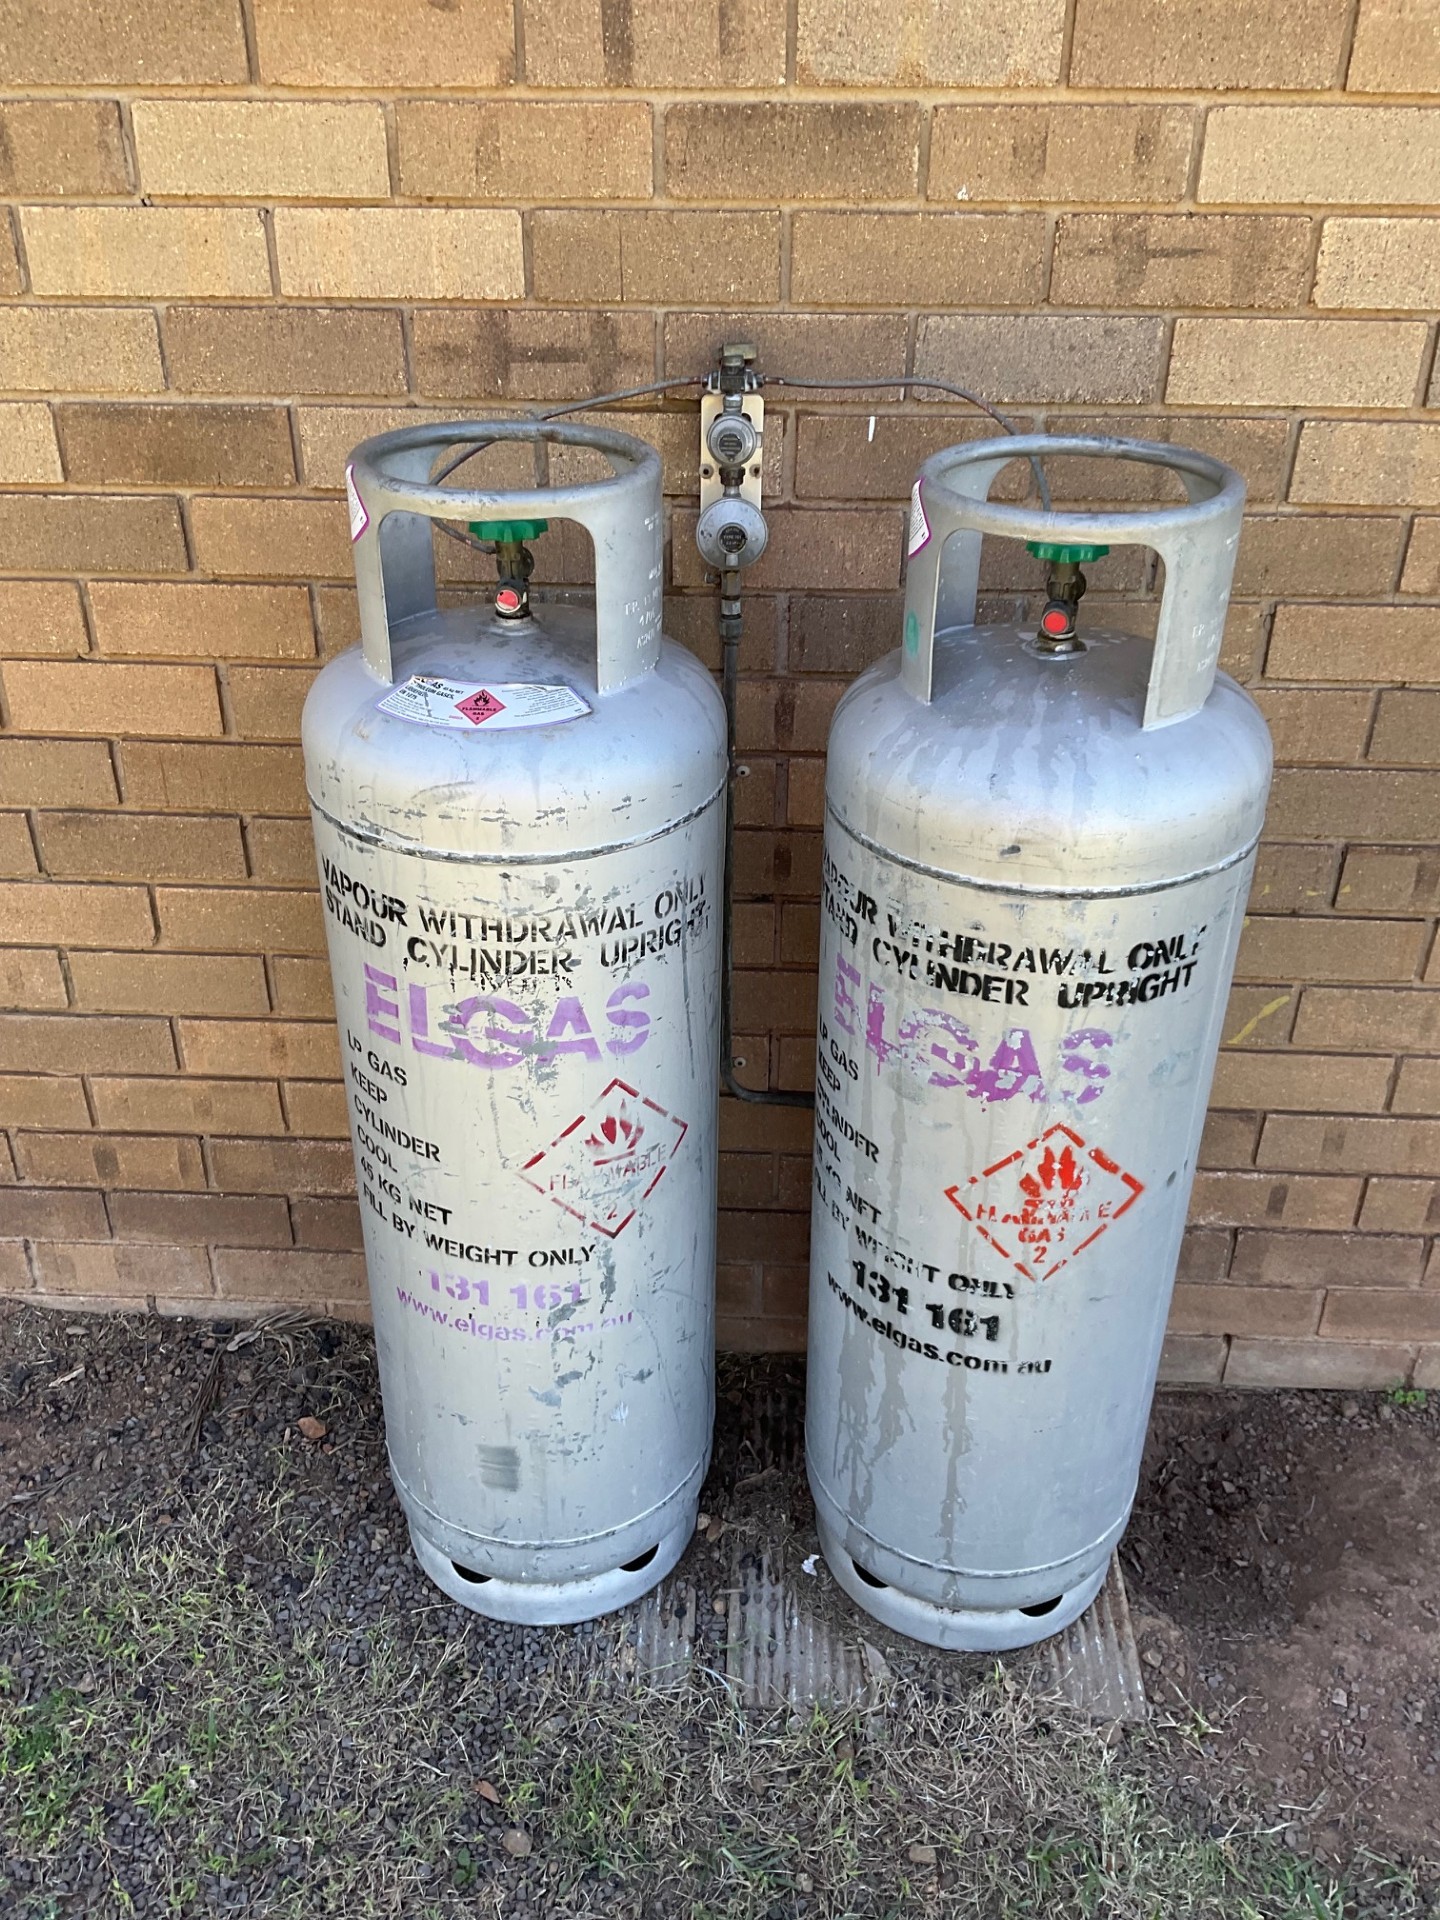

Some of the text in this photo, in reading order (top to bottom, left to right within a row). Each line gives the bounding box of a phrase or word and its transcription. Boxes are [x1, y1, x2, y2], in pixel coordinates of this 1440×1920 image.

[321, 852, 408, 927] VAPOUR
[418, 902, 645, 943] WITHDRAWAL
[325, 884, 387, 948] STAND
[407, 936, 575, 982] CYLINDER
[1058, 960, 1198, 1009] UPRIGHT
[363, 962, 651, 1070] ELGAS
[835, 951, 1114, 1105] ELGAS
[347, 1029, 408, 1087] LP GAS
[350, 1060, 388, 1104] KEEP
[830, 1039, 858, 1081] GAS
[354, 1093, 441, 1162] CYLINDER
[357, 1124, 398, 1173] COOL
[816, 1109, 841, 1163] COOL
[360, 1156, 453, 1226] 45 KG NET
[846, 1185, 882, 1225] NET
[363, 1181, 597, 1268] FILL BY WEIGHT ONLY
[1032, 1246, 1048, 1264] 2
[428, 1268, 582, 1310] 131 161
[852, 1259, 1000, 1342] 131 161
